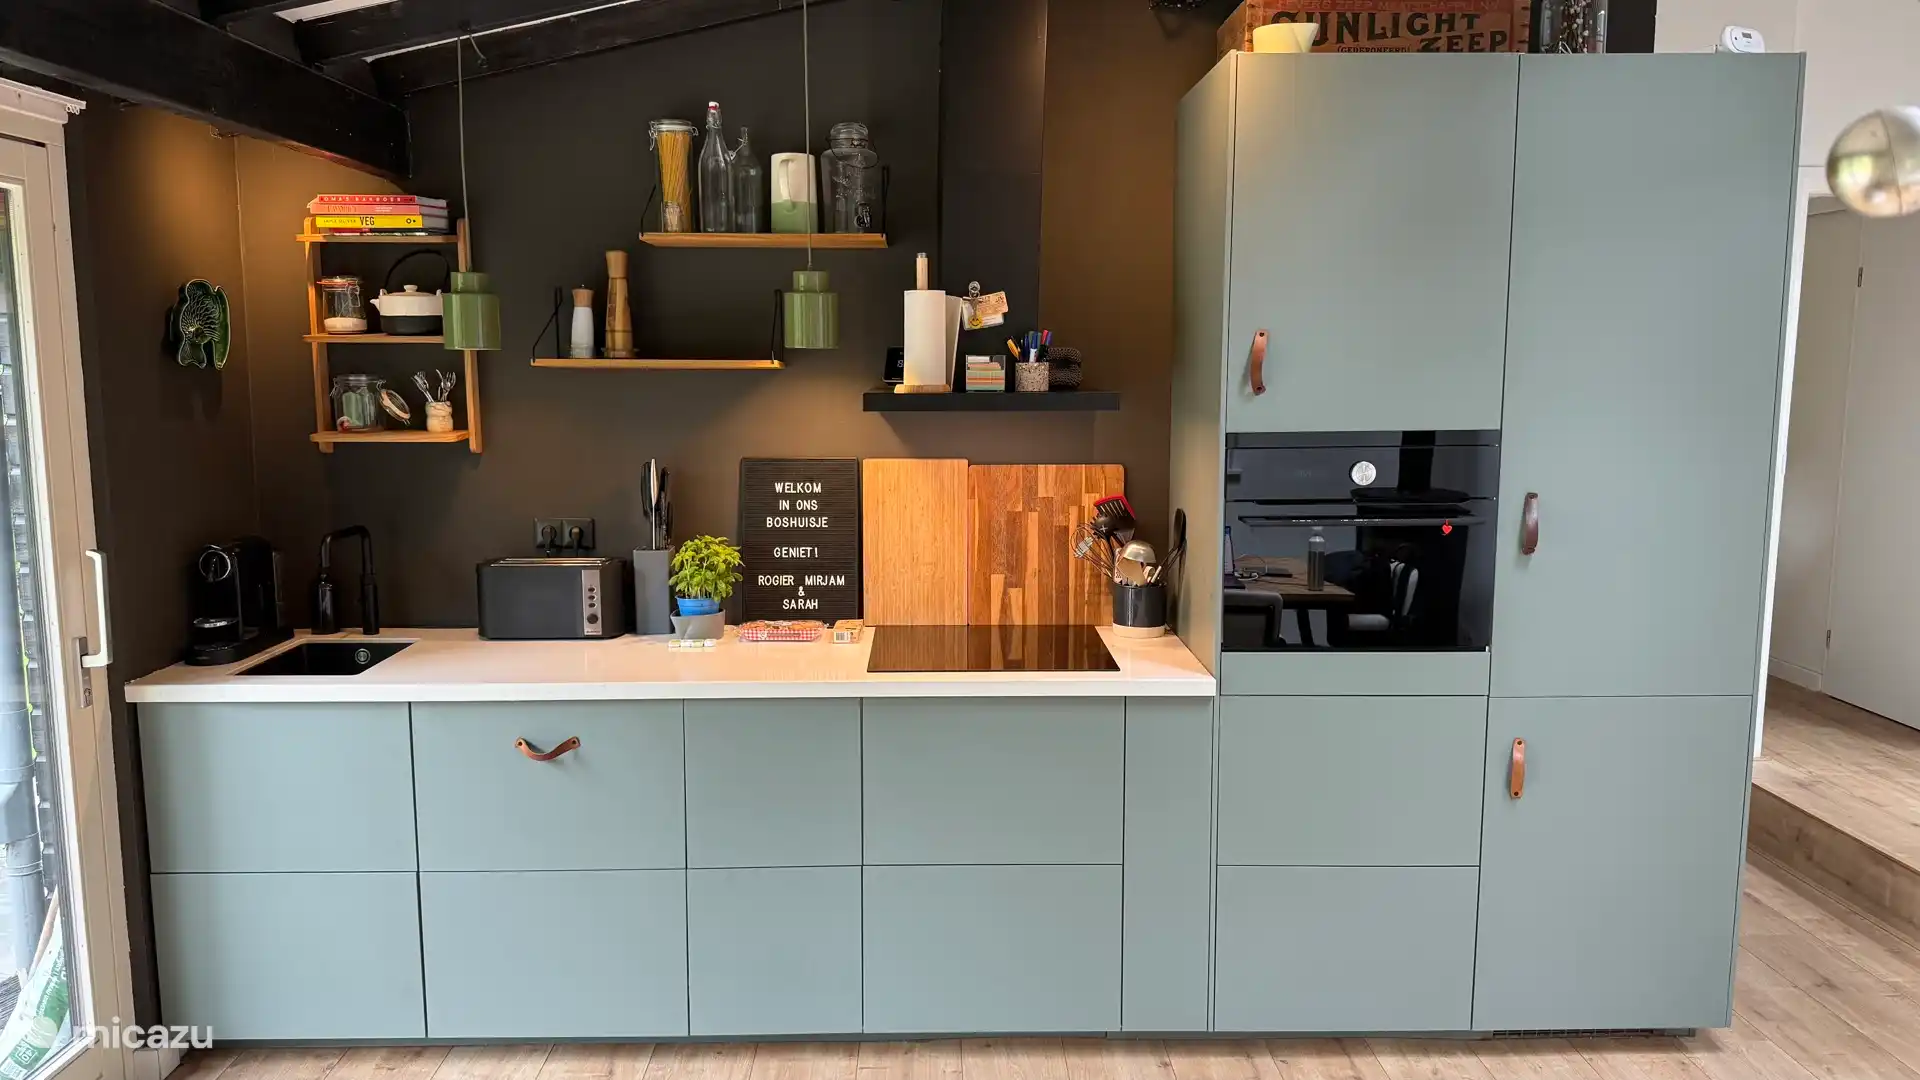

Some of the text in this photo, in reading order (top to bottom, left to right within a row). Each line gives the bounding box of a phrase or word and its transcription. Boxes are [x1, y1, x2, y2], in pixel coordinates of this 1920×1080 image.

[1417, 30, 1508, 52] ZEEP
[359, 216, 375, 226] VEG
[774, 482, 822, 494] WELKOM
[779, 499, 818, 511] IN ONS
[766, 516, 829, 528] BOSHUISJE
[757, 574, 845, 586] ROGIER MIRJAM
[797, 585, 806, 597] &
[782, 598, 819, 610] SARAH
